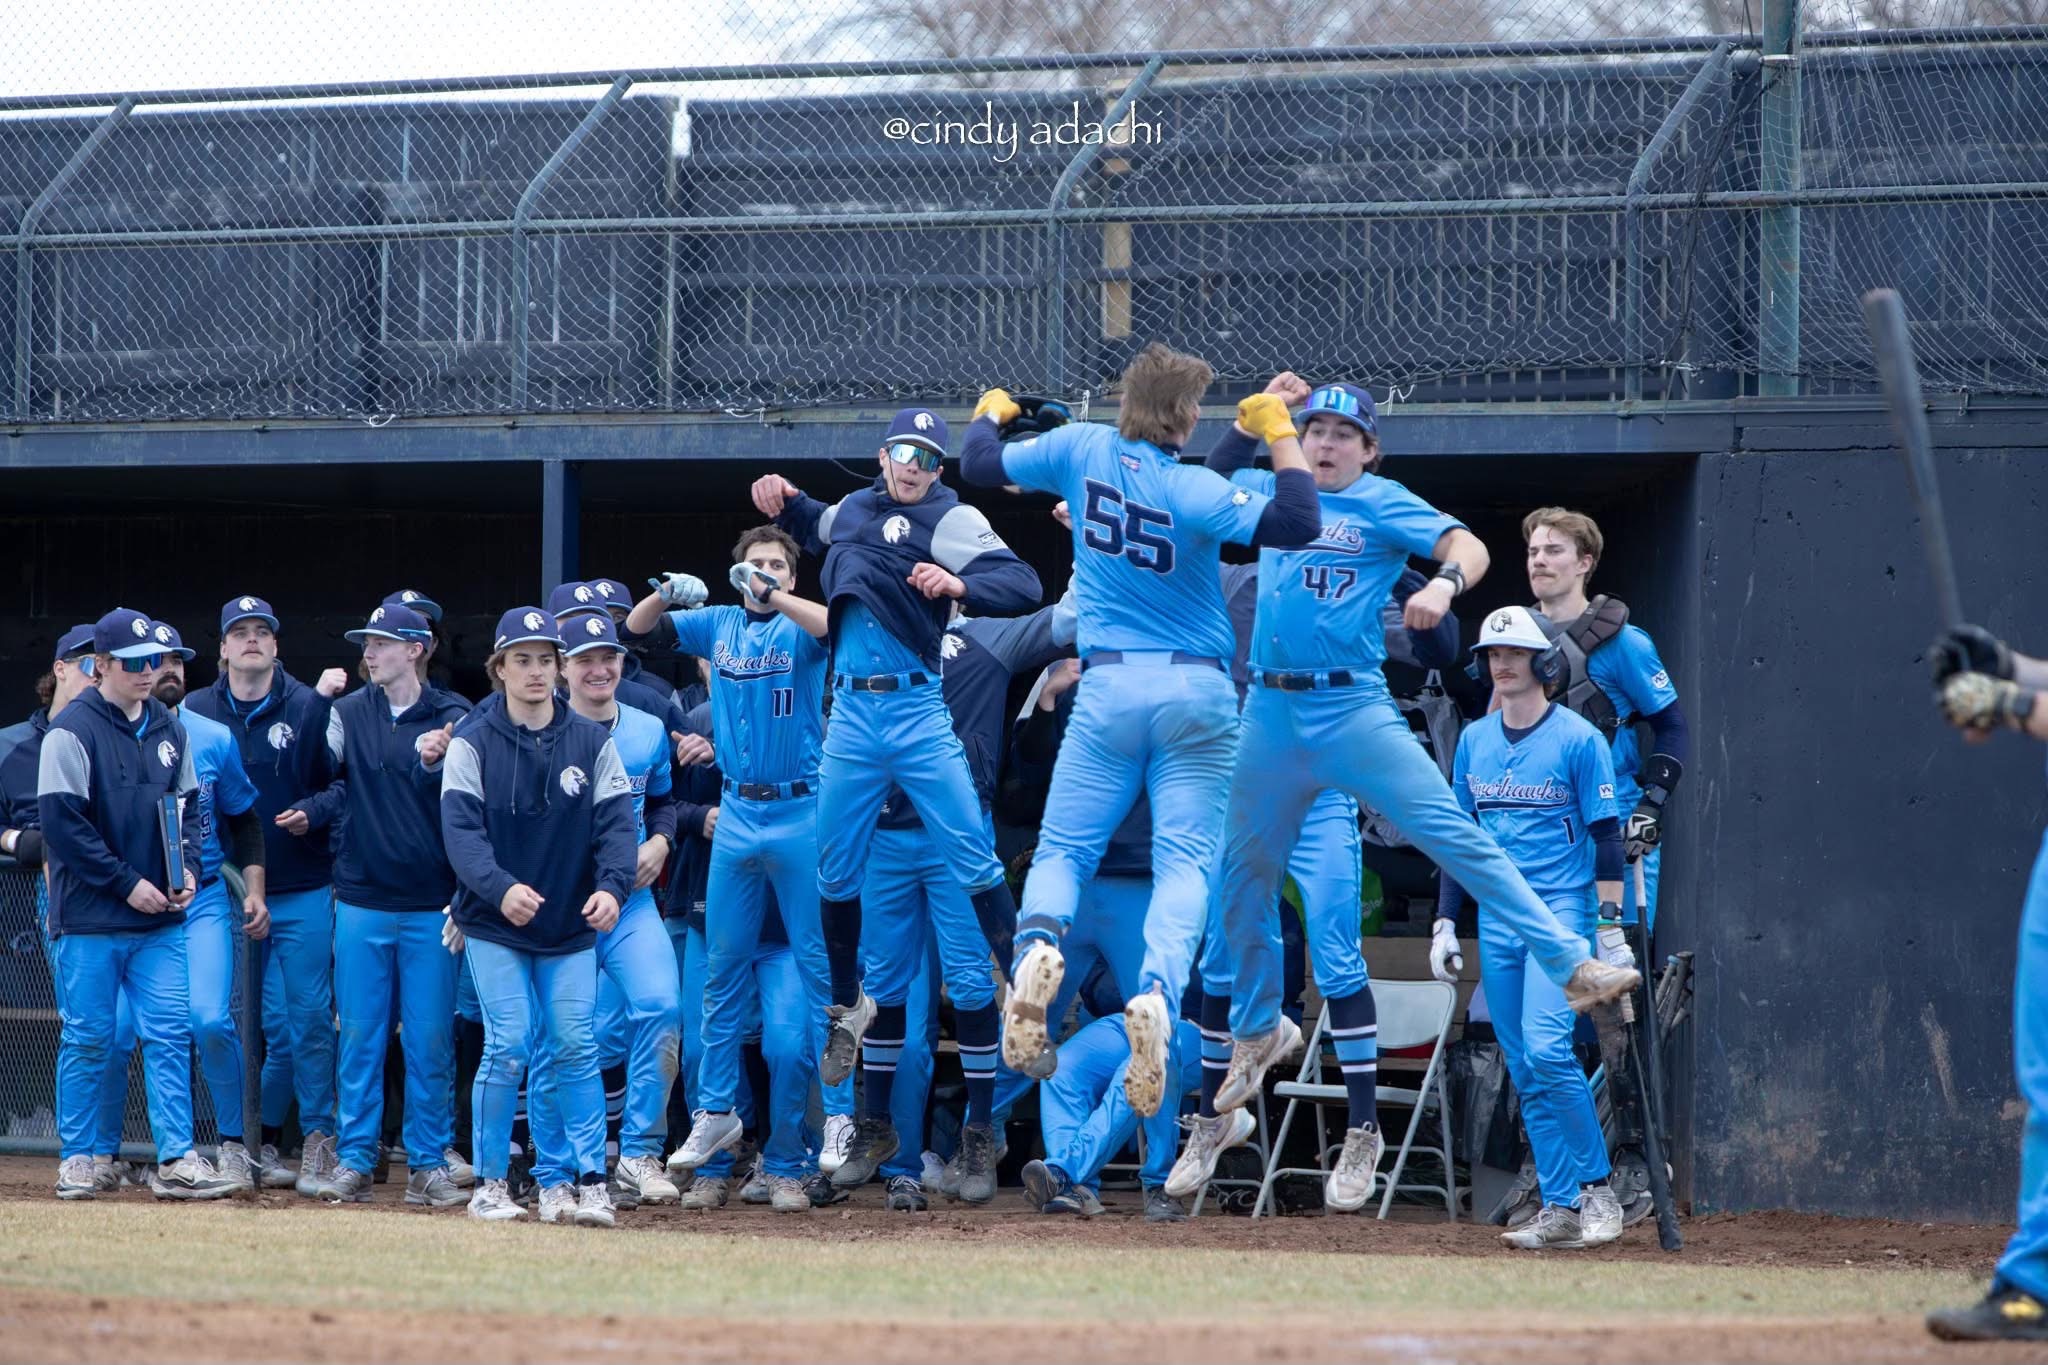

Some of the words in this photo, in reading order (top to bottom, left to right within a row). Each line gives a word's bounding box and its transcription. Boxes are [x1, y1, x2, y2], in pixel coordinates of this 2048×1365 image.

[1084, 477, 1175, 575] 55
[1302, 565, 1358, 600] 47
[772, 688, 793, 718] 11
[1561, 815, 1576, 846] 1
